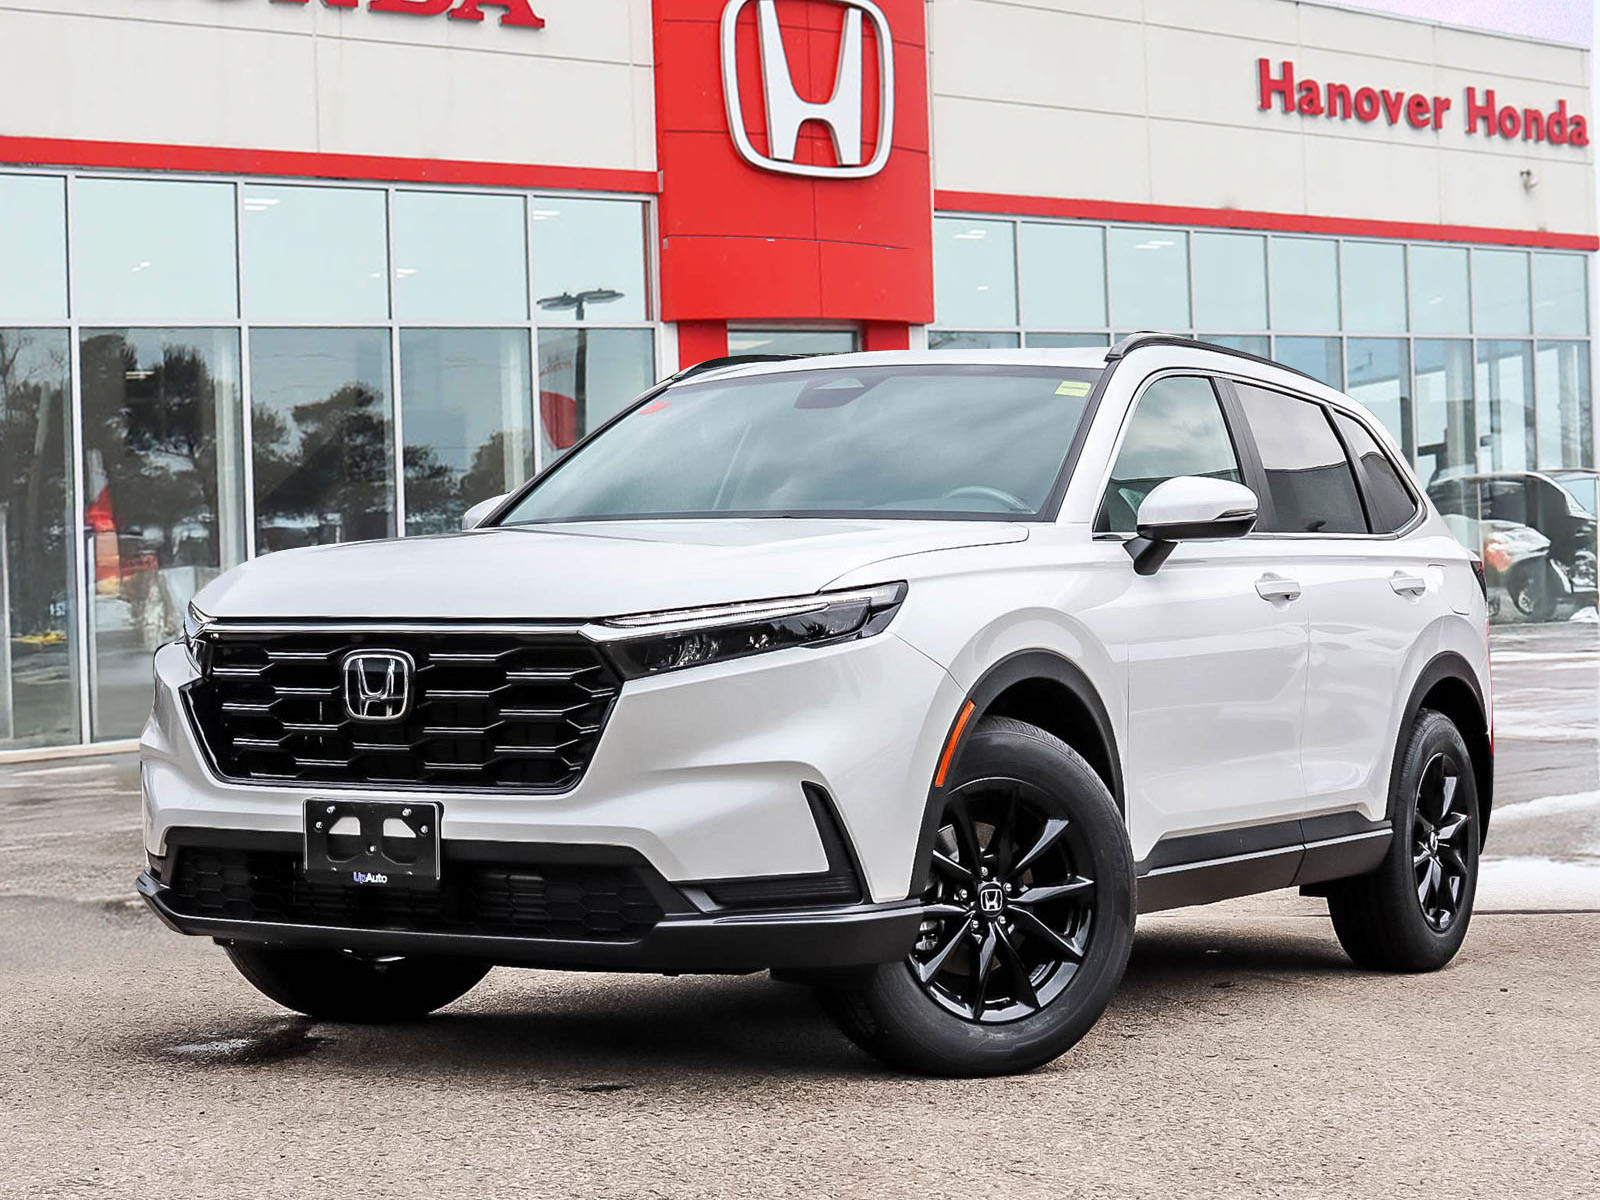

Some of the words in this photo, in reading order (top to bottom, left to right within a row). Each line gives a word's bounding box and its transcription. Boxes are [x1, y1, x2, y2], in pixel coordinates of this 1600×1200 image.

[1257, 58, 1452, 129] Hanover
[1465, 86, 1590, 147] Honda
[353, 871, 388, 885] UpAuto
